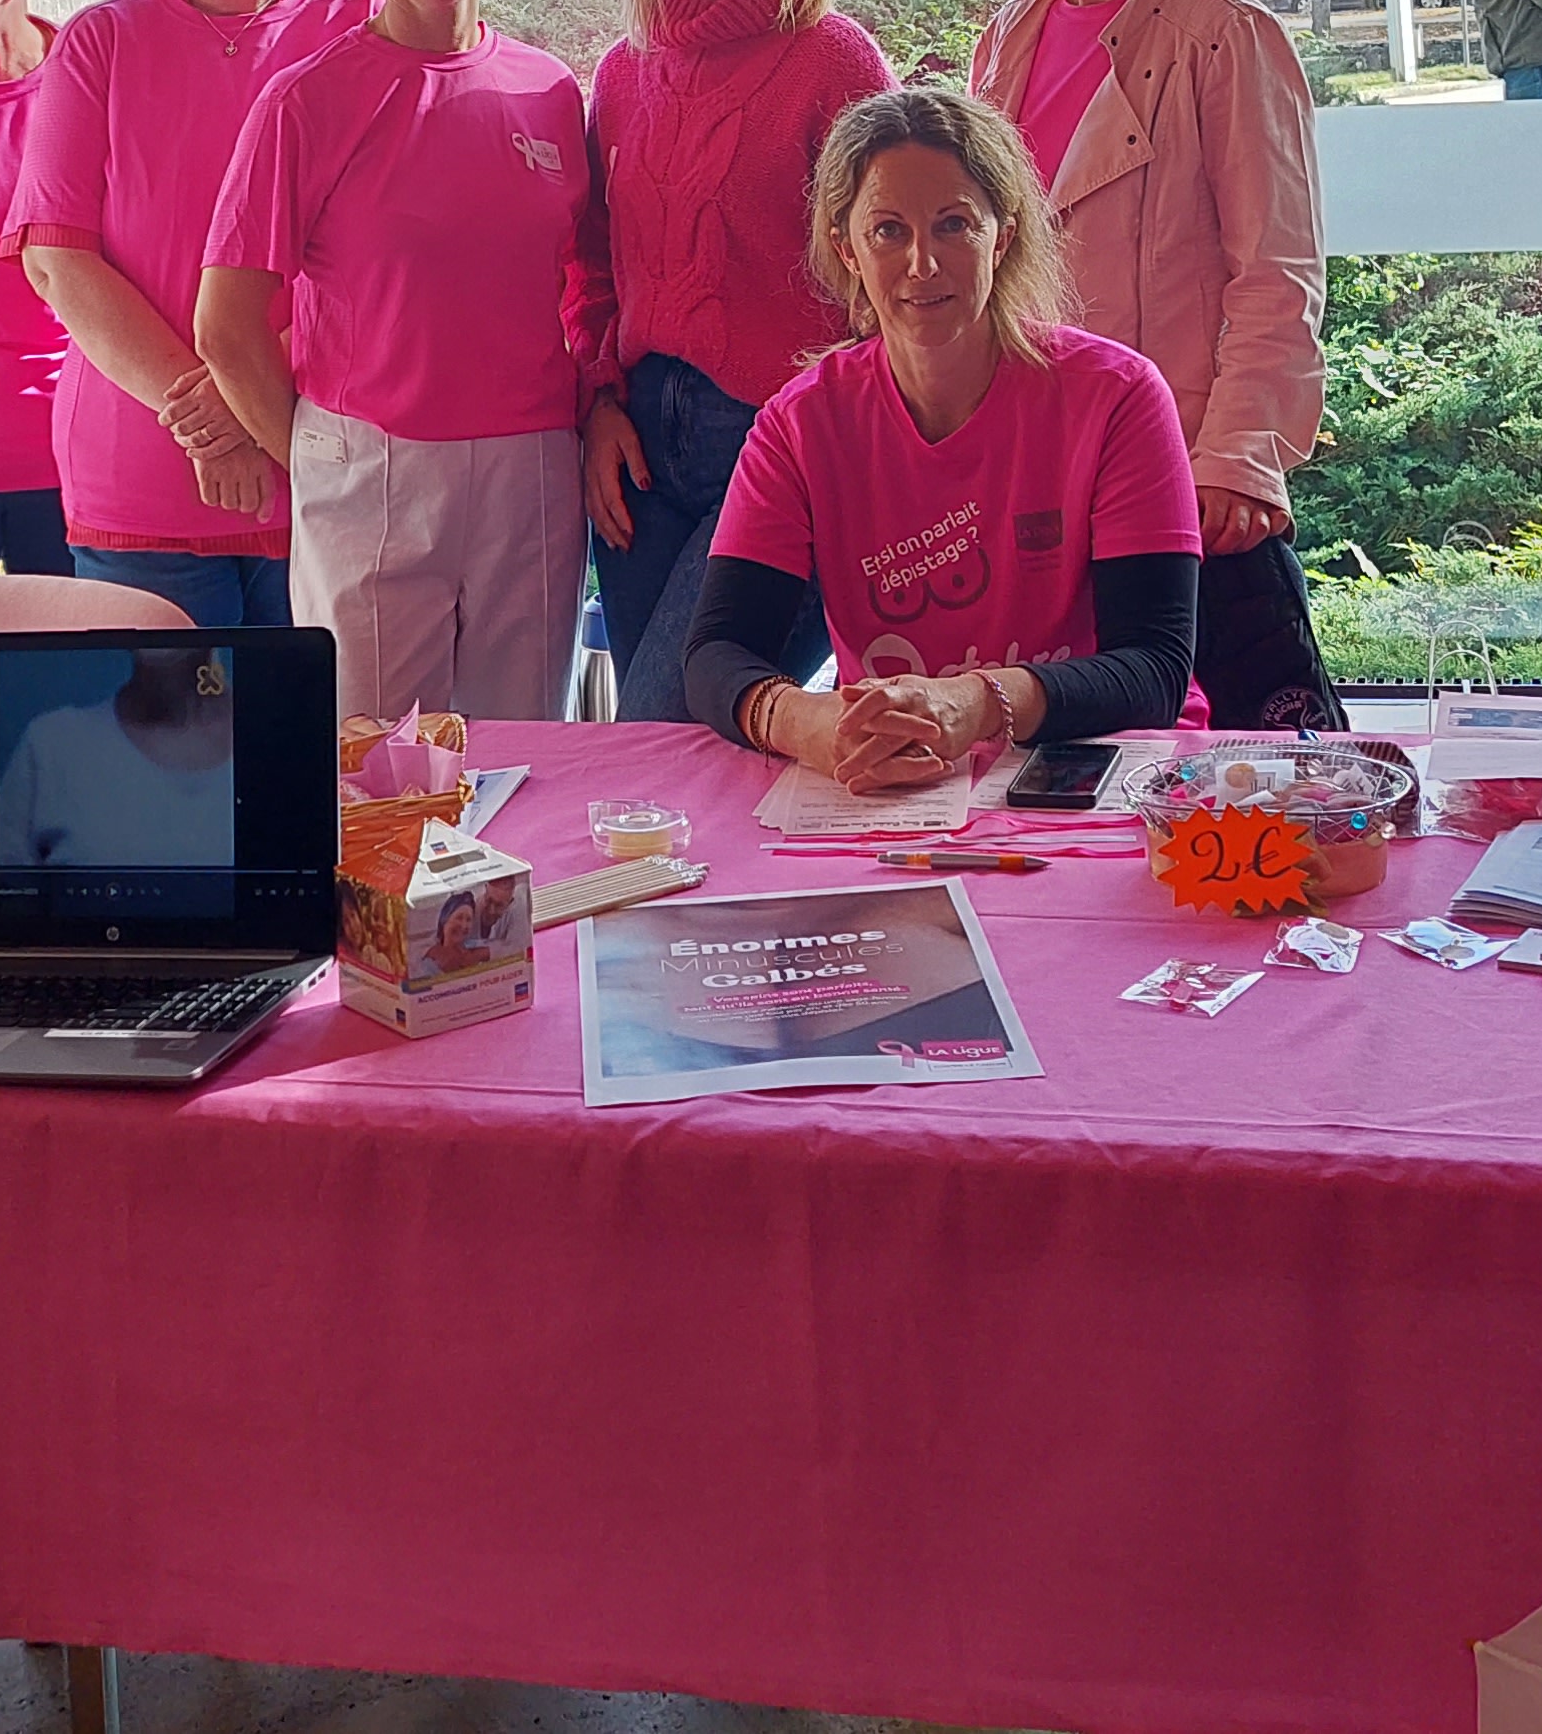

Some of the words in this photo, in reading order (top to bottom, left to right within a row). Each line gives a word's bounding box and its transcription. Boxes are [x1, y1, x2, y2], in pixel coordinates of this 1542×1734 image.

[861, 555, 881, 578] Et
[881, 543, 895, 566] si
[896, 534, 922, 556] on
[920, 499, 981, 550] parlait
[880, 537, 970, 595] dépistage
[966, 525, 980, 545] ?
[1264, 689, 1309, 722] RALLYE
[1190, 830, 1241, 884] 2
[1243, 826, 1292, 879] €
[659, 942, 904, 974] Minuscules
[669, 930, 887, 957] Énormes
[701, 963, 868, 988] Galbés
